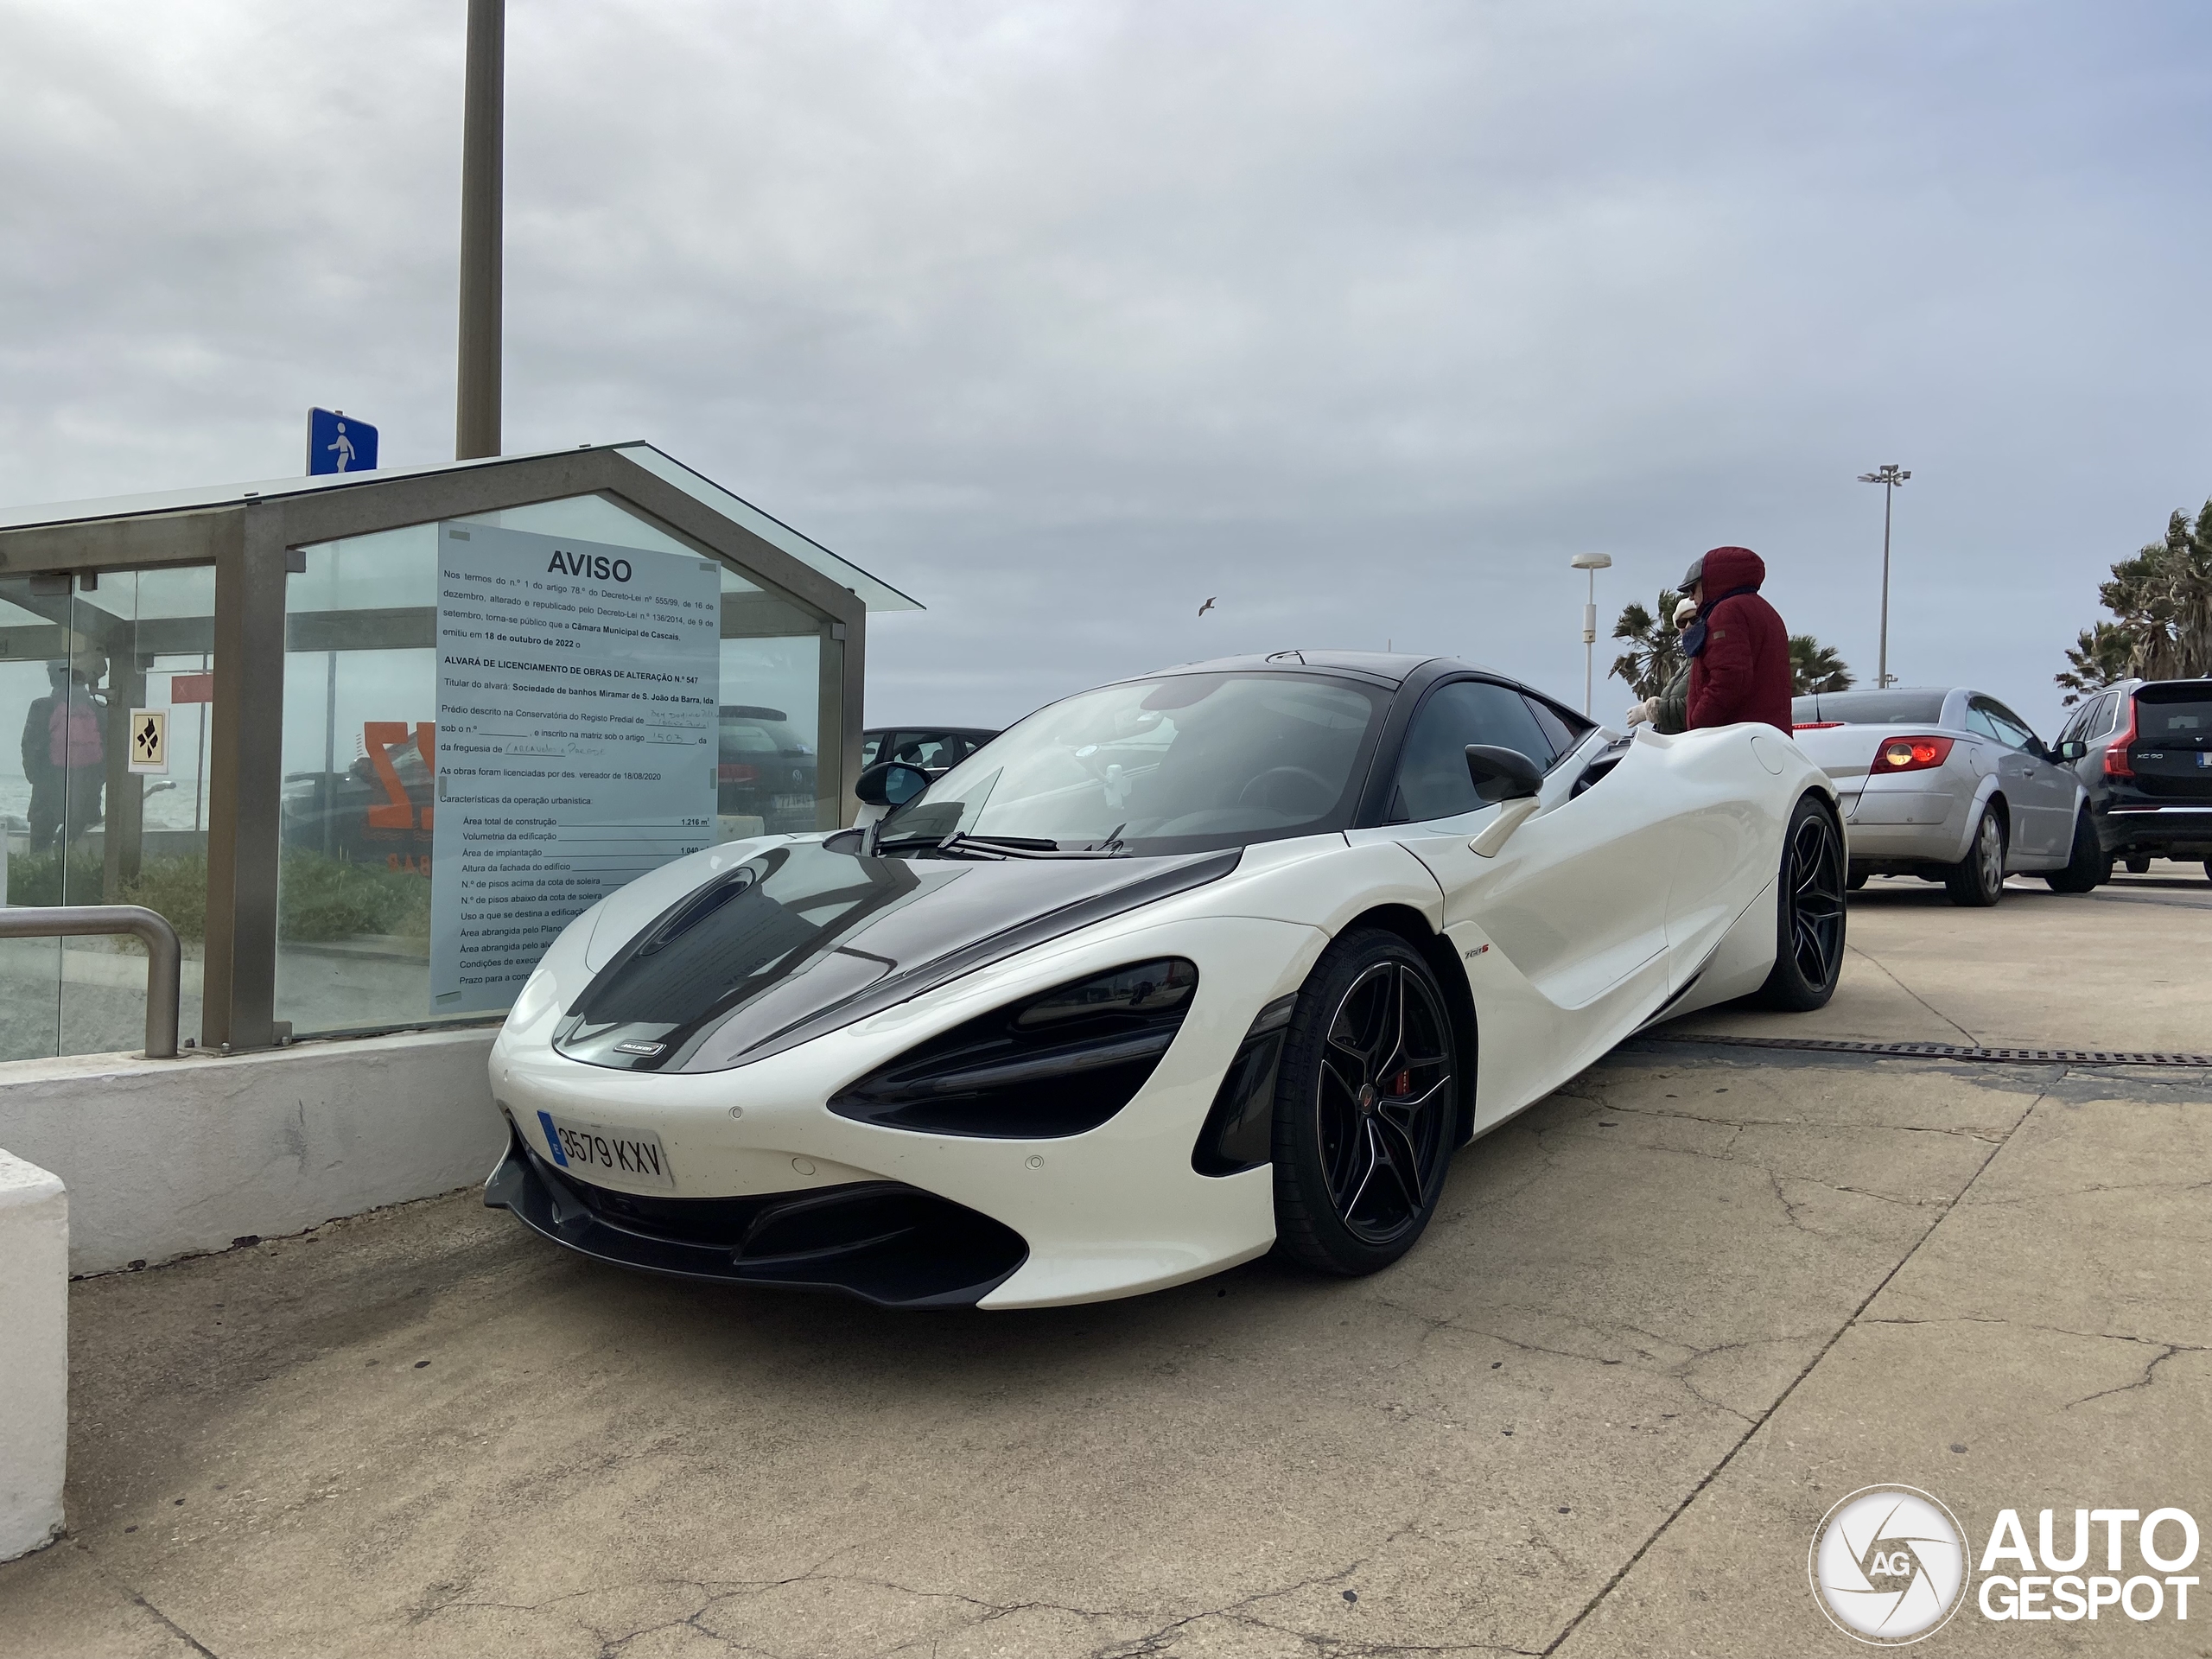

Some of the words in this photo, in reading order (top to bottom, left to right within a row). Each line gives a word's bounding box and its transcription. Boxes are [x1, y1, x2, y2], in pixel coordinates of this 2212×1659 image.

[547, 550, 632, 582] AVISO
[443, 569, 460, 579] Nos
[464, 572, 492, 583] termos
[495, 576, 506, 585] do
[532, 581, 543, 589] do
[546, 584, 567, 593] artigo
[601, 589, 641, 601] Decreto-Lei
[655, 596, 680, 607] 555/99,
[443, 589, 486, 602] dezembro,
[489, 595, 522, 605] alterado
[532, 601, 576, 611] republicado
[597, 606, 637, 618] Decreto-Lei
[443, 609, 483, 620] setembro,
[486, 613, 518, 623] torna-se
[519, 617, 547, 626] público
[571, 622, 601, 632] Câmara
[602, 625, 638, 637] Municipal
[650, 630, 681, 641] Cascais,
[442, 629, 467, 637] emitiu
[484, 631, 494, 639] 18
[509, 635, 542, 644] outubro
[555, 638, 574, 647] 2022
[444, 655, 481, 666] ALVARÁ
[483, 659, 495, 667] DE
[498, 660, 568, 673] LICENCIAMENTO
[583, 667, 612, 677] OBRAS
[625, 671, 673, 682] ALTERAÇÃO
[443, 677, 470, 687] Titular
[512, 683, 555, 693] Sociedade
[568, 687, 597, 696] banhos
[599, 689, 630, 698] Miramar
[680, 695, 702, 704] Barra,
[441, 704, 468, 714] Prédio
[469, 706, 502, 715] descrito
[515, 709, 568, 719] Conservatória
[580, 713, 608, 723] Registo
[609, 714, 634, 723] Predial
[441, 724, 456, 732] sob
[625, 734, 645, 742] artigo
[440, 742, 451, 751] da
[453, 743, 490, 753] freguesia
[439, 766, 451, 774] As
[453, 767, 476, 775] obras
[478, 767, 501, 775] foram
[503, 768, 546, 777] licenciadas
[624, 772, 661, 780] 18/08/2020
[439, 794, 500, 803] Características
[513, 796, 549, 805] operação
[462, 815, 482, 825] Área
[515, 818, 557, 827] construção
[462, 832, 505, 840] Volumetria
[518, 832, 557, 841] edificação
[461, 847, 481, 857] Área
[495, 848, 542, 857] implantação
[544, 862, 571, 870] edifício
[488, 880, 509, 889] pisos
[488, 896, 509, 904] pisos
[460, 912, 477, 920] Uso
[460, 927, 479, 937] Área
[481, 927, 520, 936] abrangida
[522, 926, 539, 935] pelo
[540, 925, 562, 933] Plano
[459, 943, 479, 953] Área
[481, 942, 520, 952] abrangida
[522, 941, 539, 950] pelo
[459, 959, 502, 969] Condições
[485, 975, 503, 984] para
[558, 1127, 613, 1168] 3579
[612, 1139, 661, 1176] KXV
